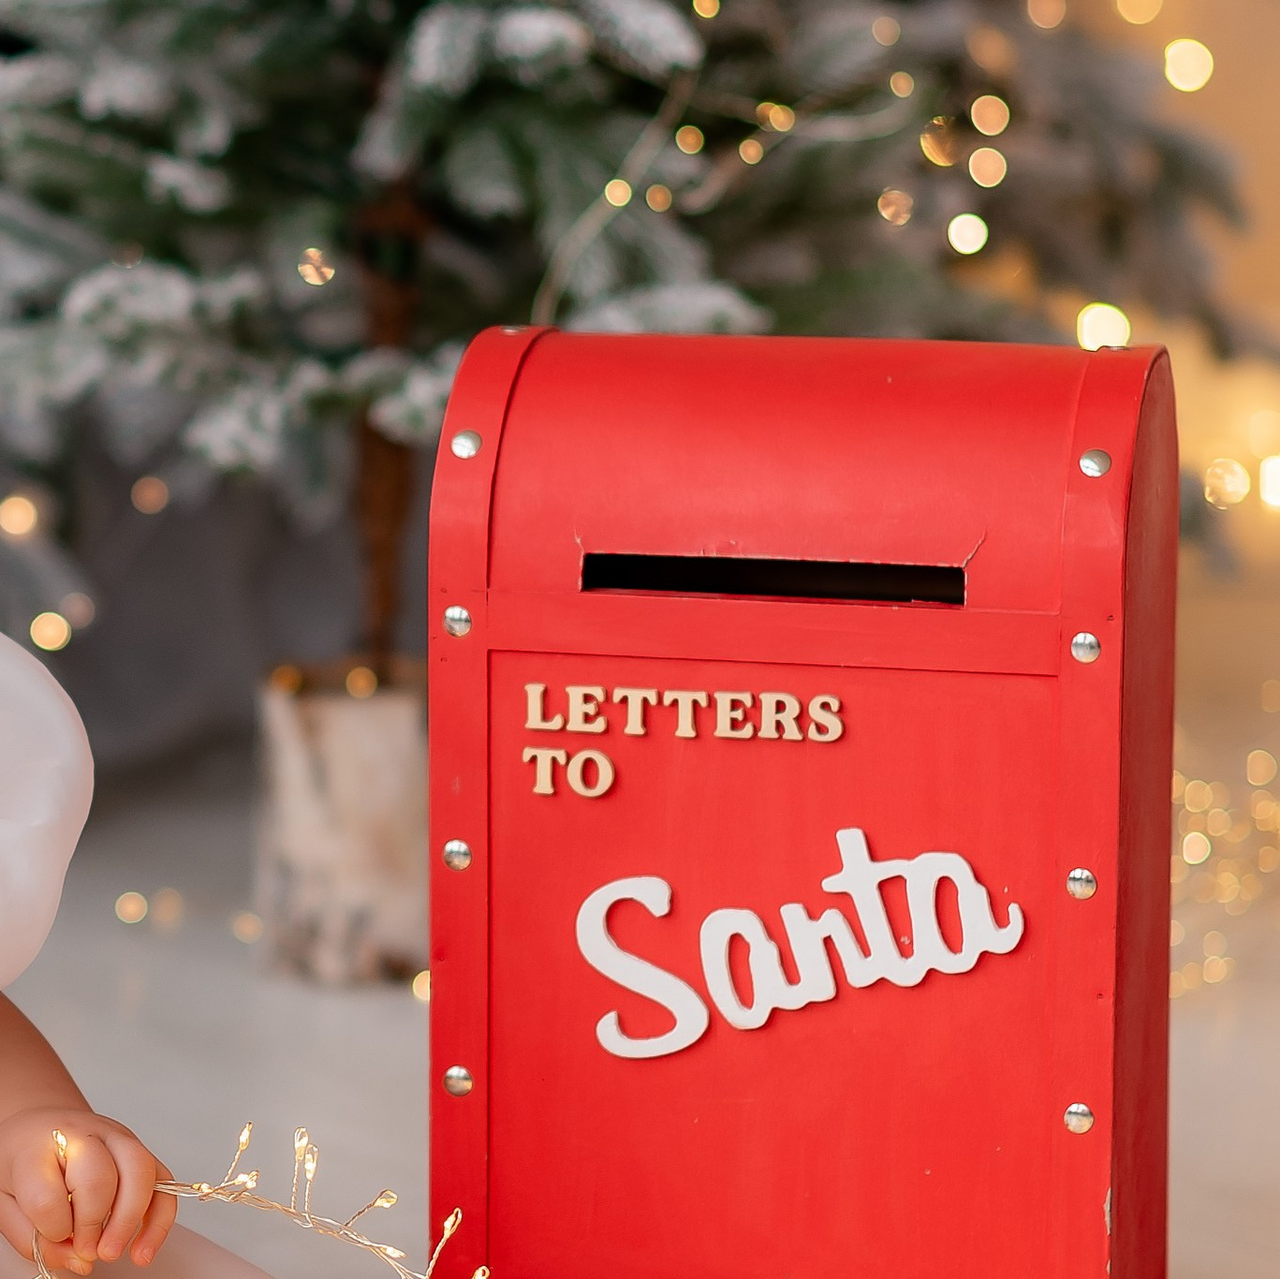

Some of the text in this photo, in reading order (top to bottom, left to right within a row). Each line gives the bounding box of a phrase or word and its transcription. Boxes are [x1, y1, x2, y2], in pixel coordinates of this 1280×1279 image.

[523, 683, 845, 742] LETTERS
[522, 747, 615, 798] TO
[575, 827, 1025, 1059] Santa
